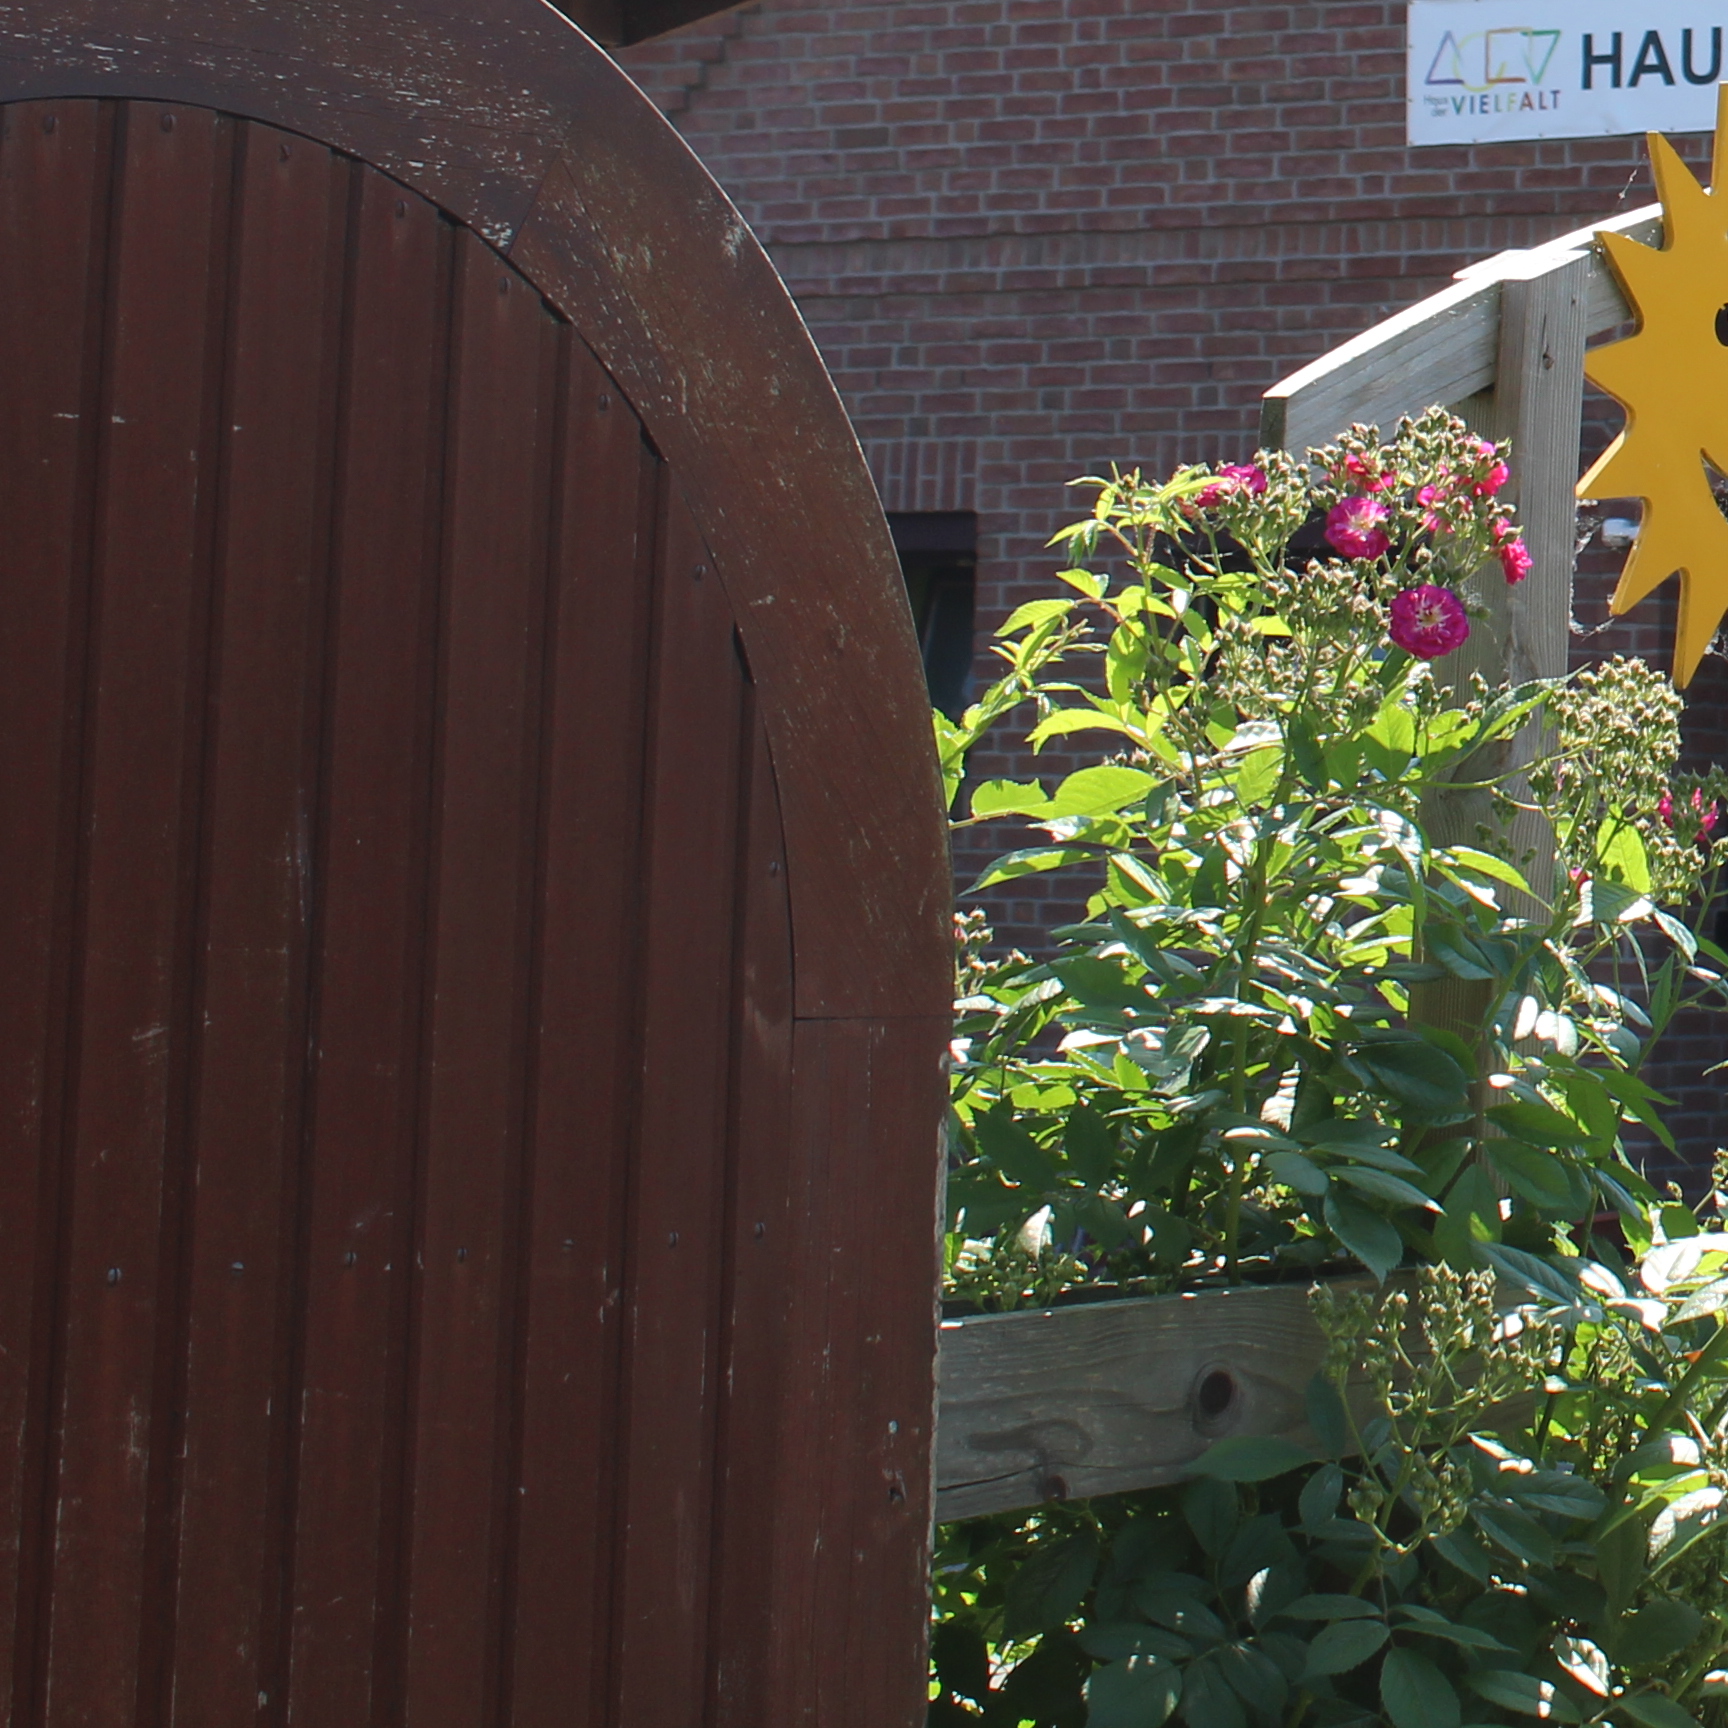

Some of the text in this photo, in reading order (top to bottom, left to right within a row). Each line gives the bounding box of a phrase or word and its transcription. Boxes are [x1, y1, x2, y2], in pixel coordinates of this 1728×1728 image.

[1423, 95, 1448, 106] Haus
[1431, 90, 1561, 117] der VIELFALT
